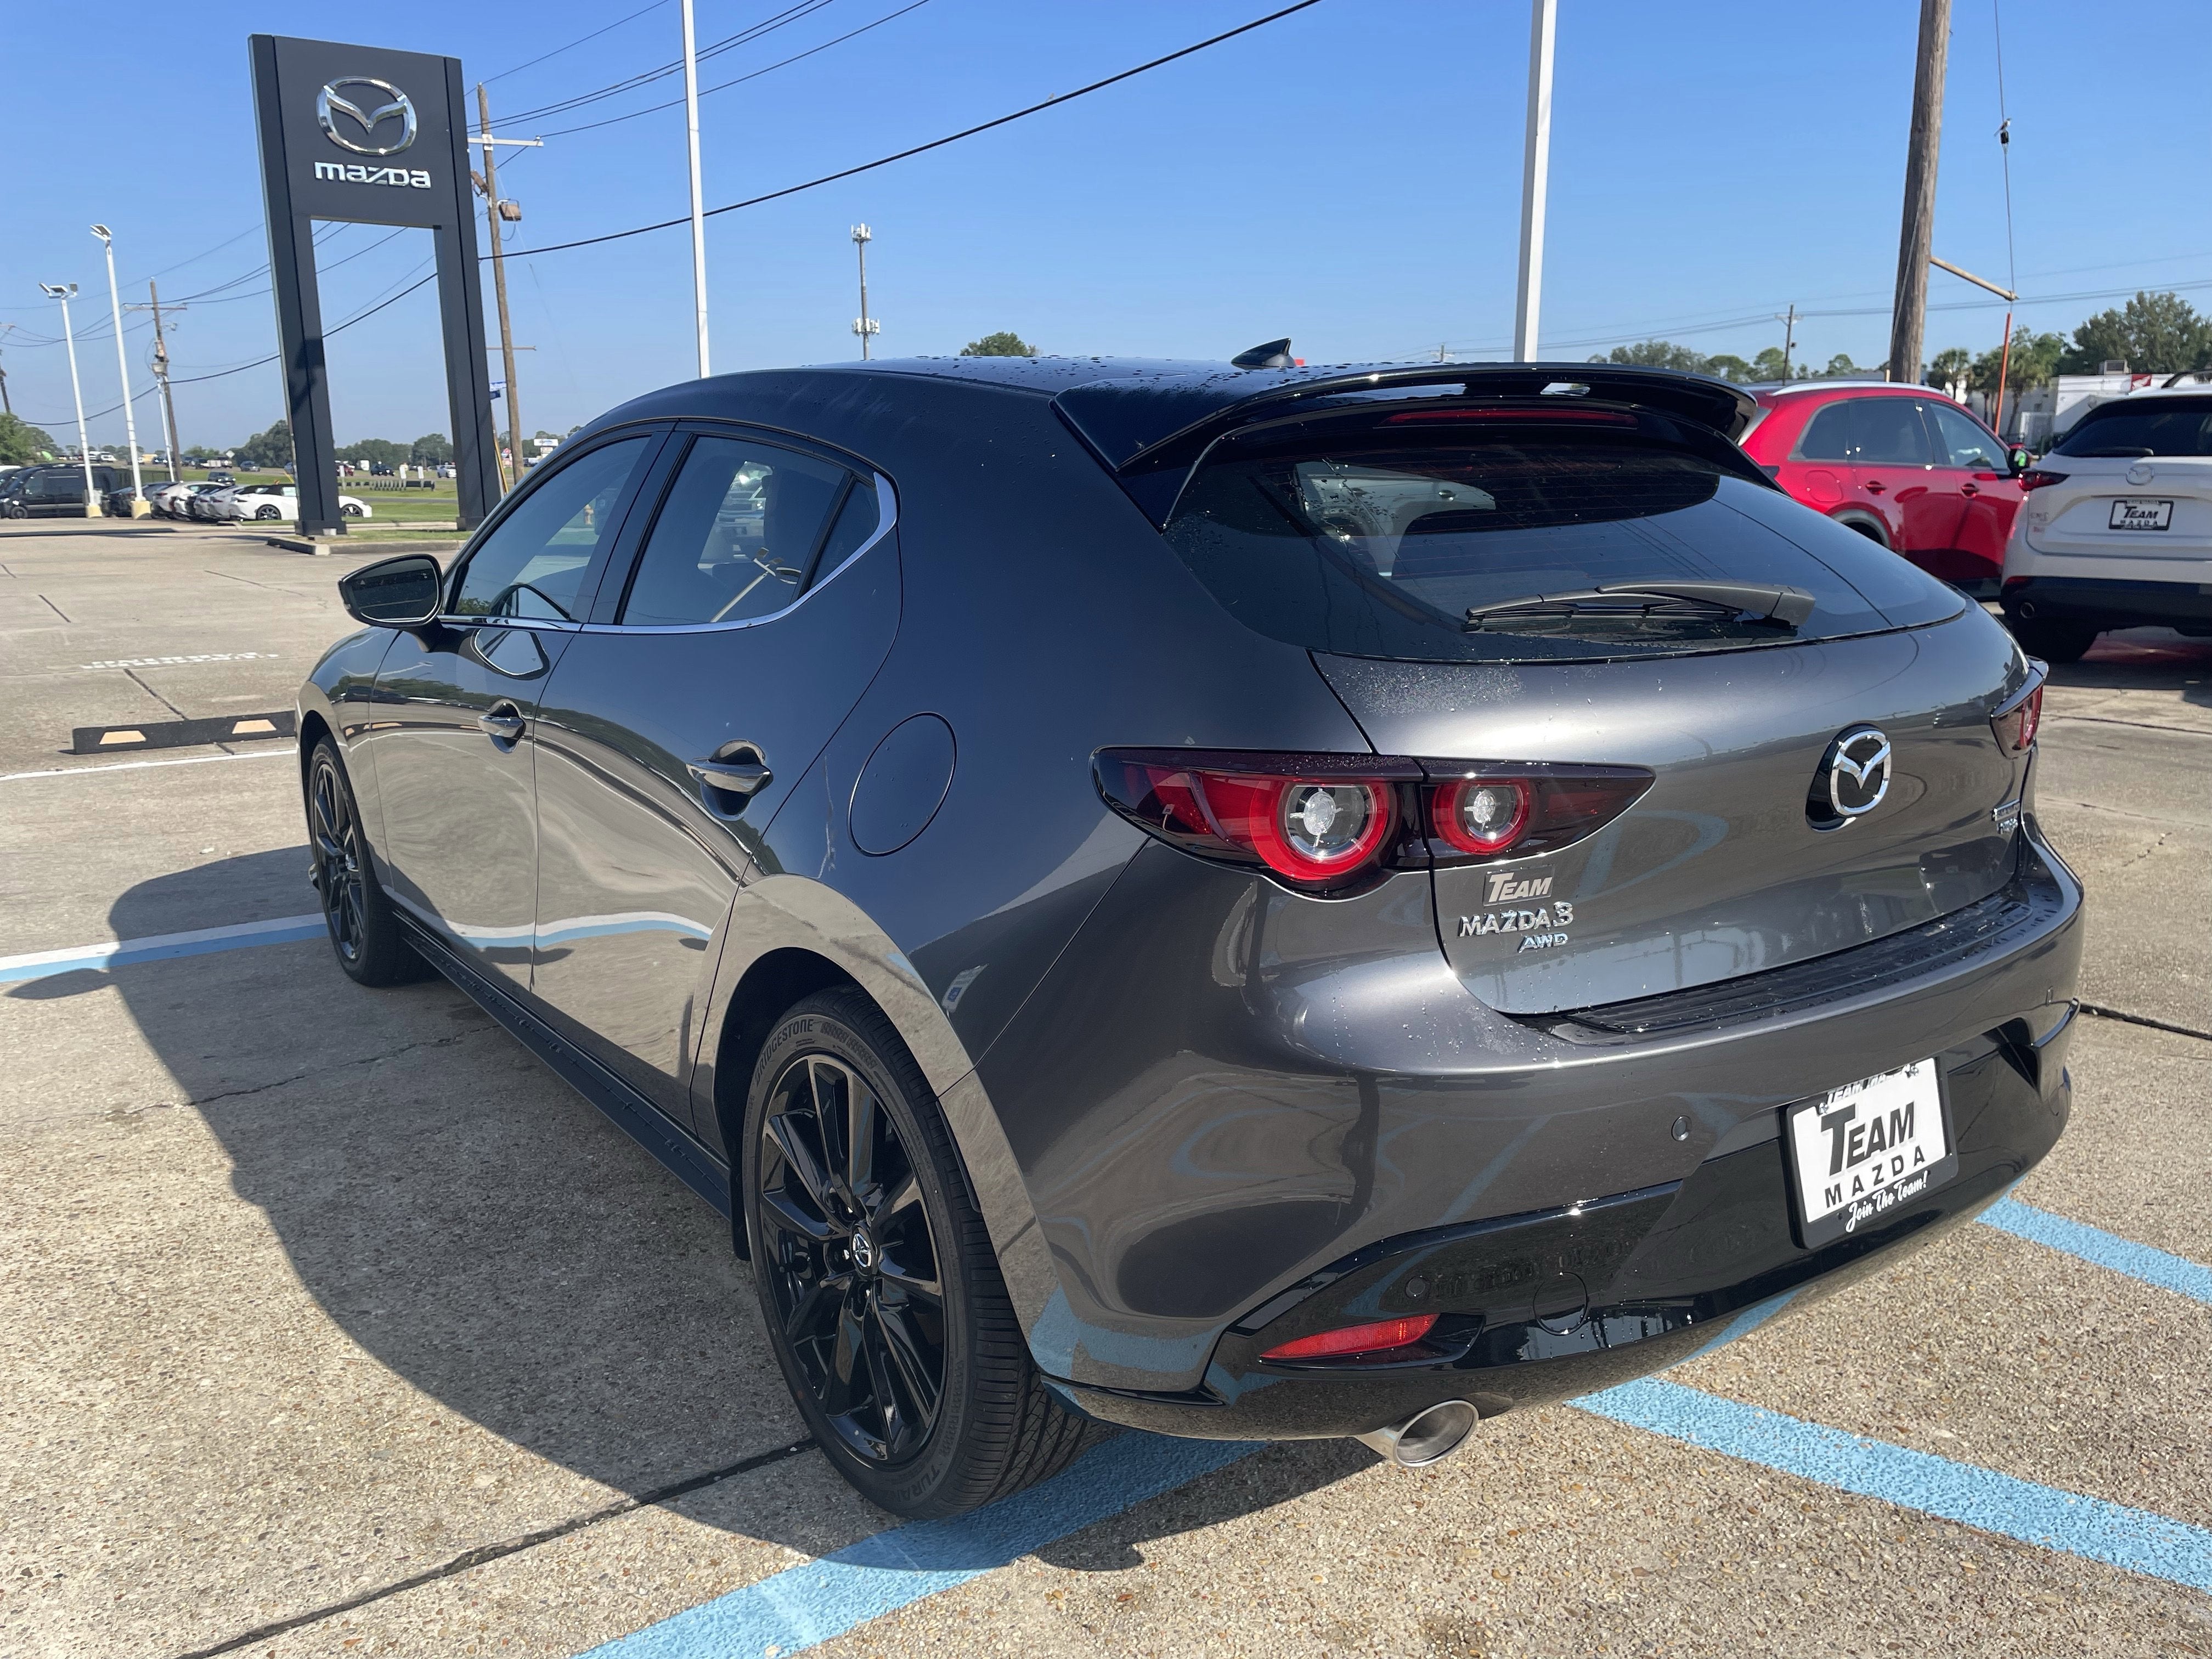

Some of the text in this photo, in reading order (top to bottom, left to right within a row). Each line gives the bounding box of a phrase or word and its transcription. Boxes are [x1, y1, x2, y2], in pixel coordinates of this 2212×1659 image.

[2124, 506, 2158, 518] TEAM
[1488, 872, 1553, 902] TEAM
[1517, 933, 1568, 953] AWD
[755, 1019, 814, 1086] BRIDGESTONE
[1821, 1101, 1915, 1176] TEAM
[1825, 1146, 1925, 1208] MAZDA
[1846, 1170, 1928, 1232] Join The Team!
